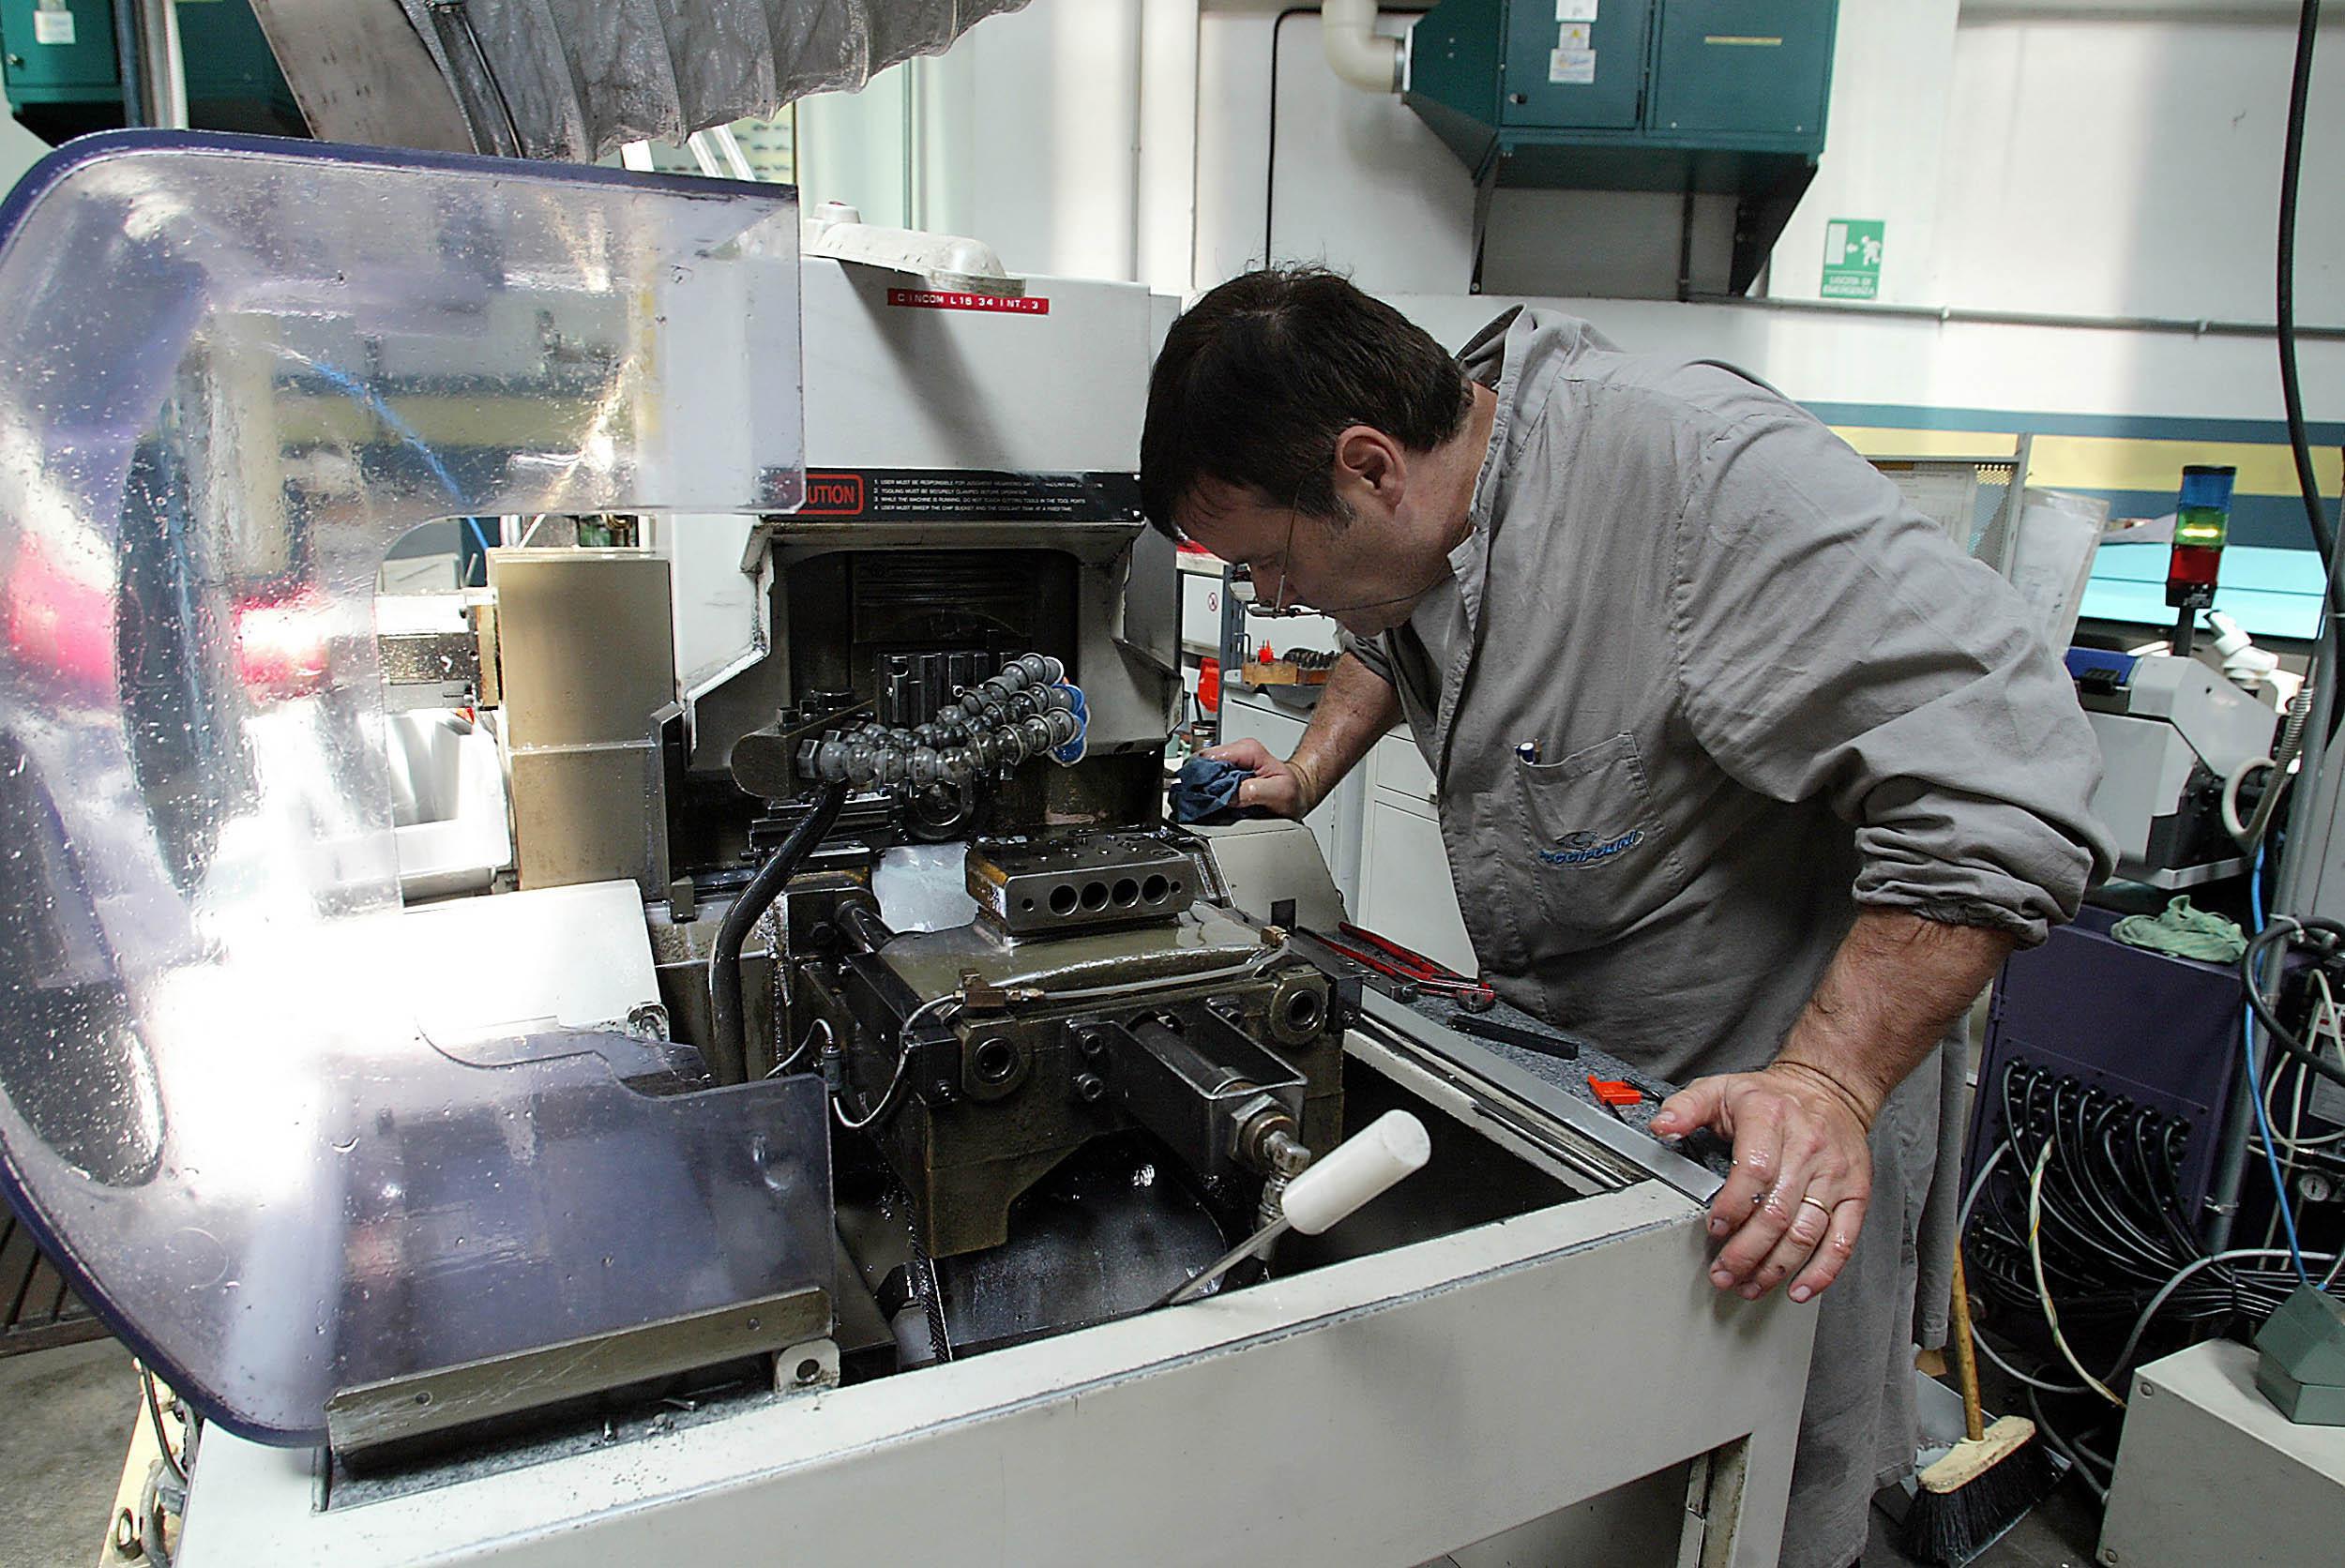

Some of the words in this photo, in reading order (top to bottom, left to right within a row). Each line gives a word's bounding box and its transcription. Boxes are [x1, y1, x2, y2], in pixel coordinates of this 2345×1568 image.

[978, 297, 993, 307] 34
[1032, 300, 1039, 310] 3
[807, 485, 855, 504] UTION
